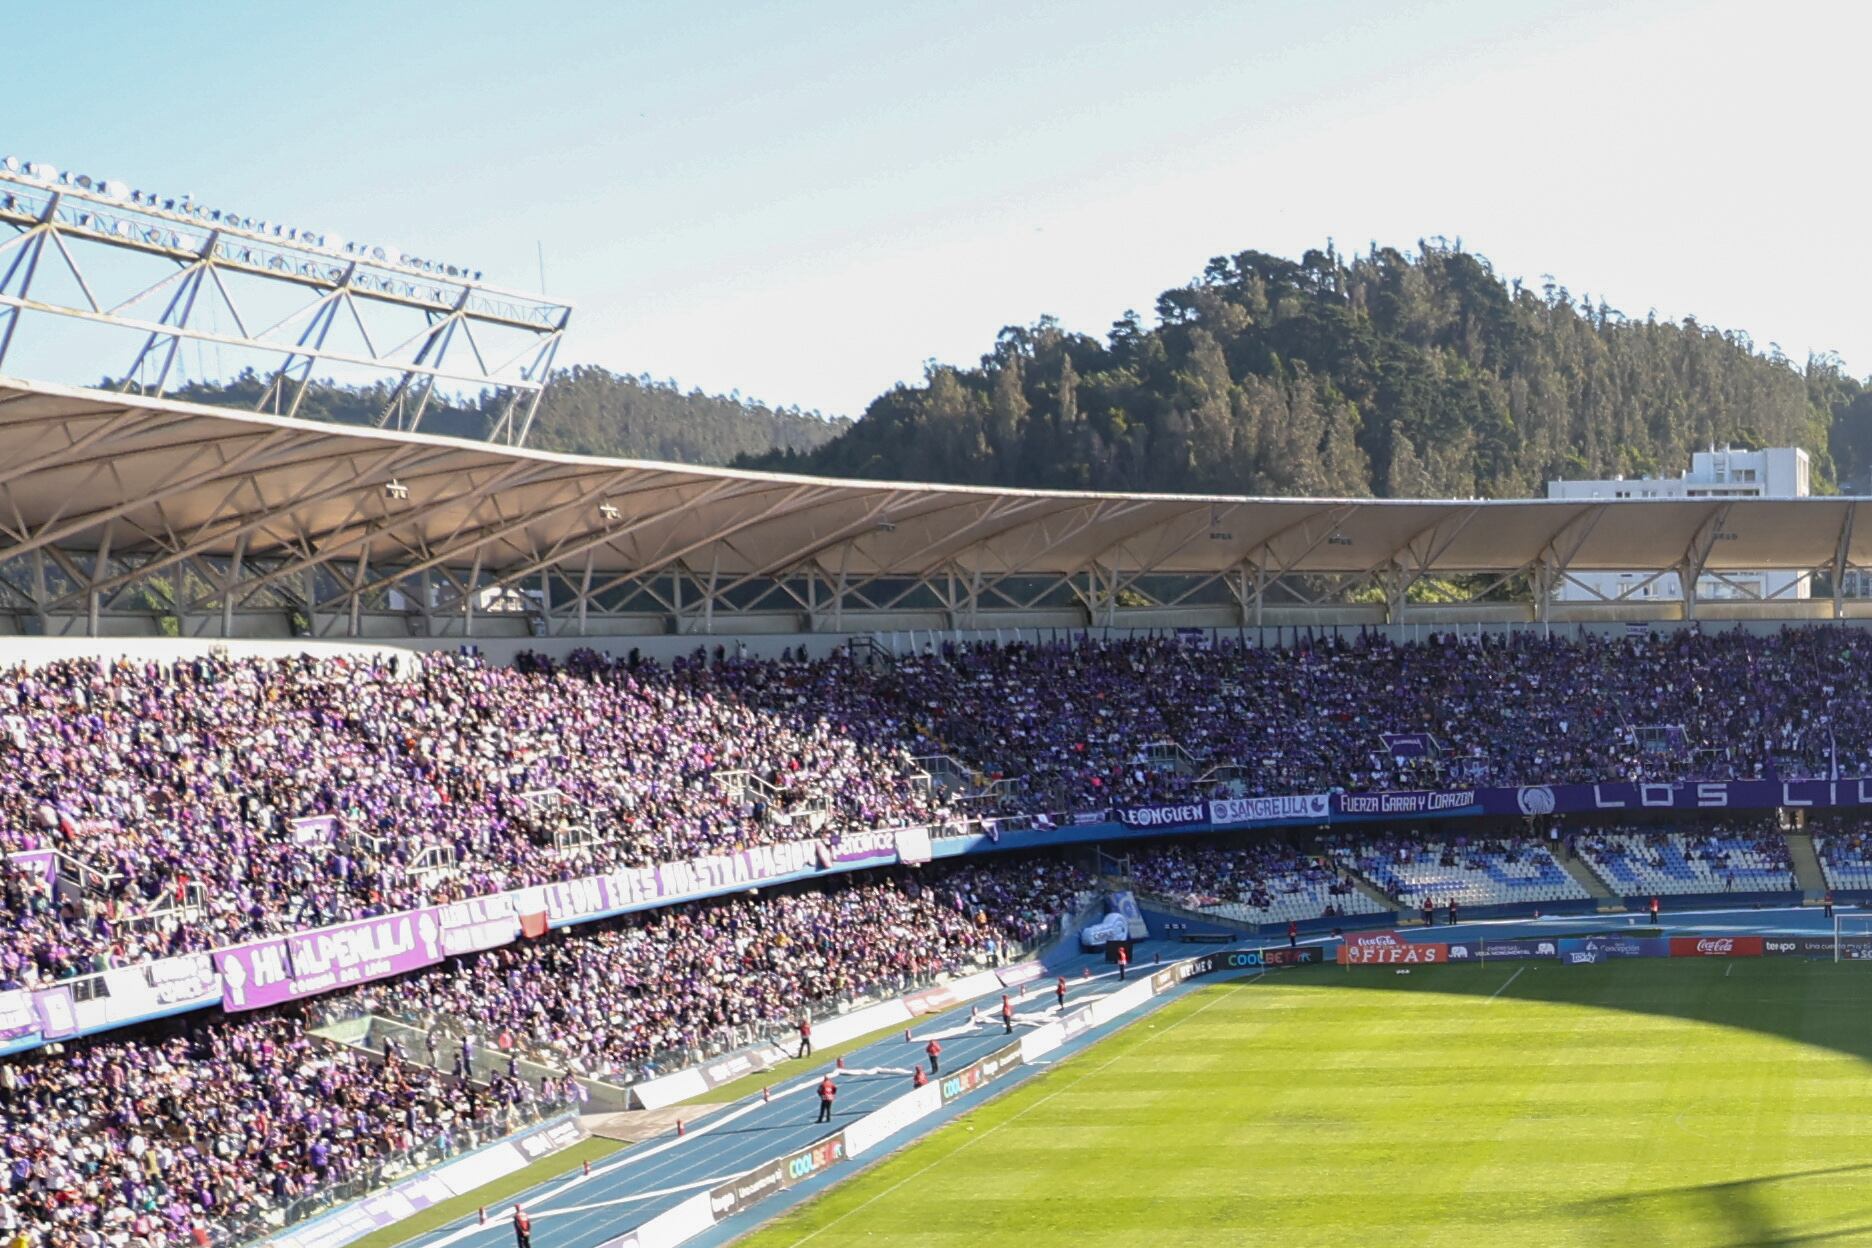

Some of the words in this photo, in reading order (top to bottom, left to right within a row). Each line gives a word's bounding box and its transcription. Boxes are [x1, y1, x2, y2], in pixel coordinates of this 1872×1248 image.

[1341, 794, 1379, 812] FUERZA
[1381, 794, 1417, 812] GARRA
[1428, 790, 1475, 810] CORAZON
[1594, 783, 1728, 807] LOS
